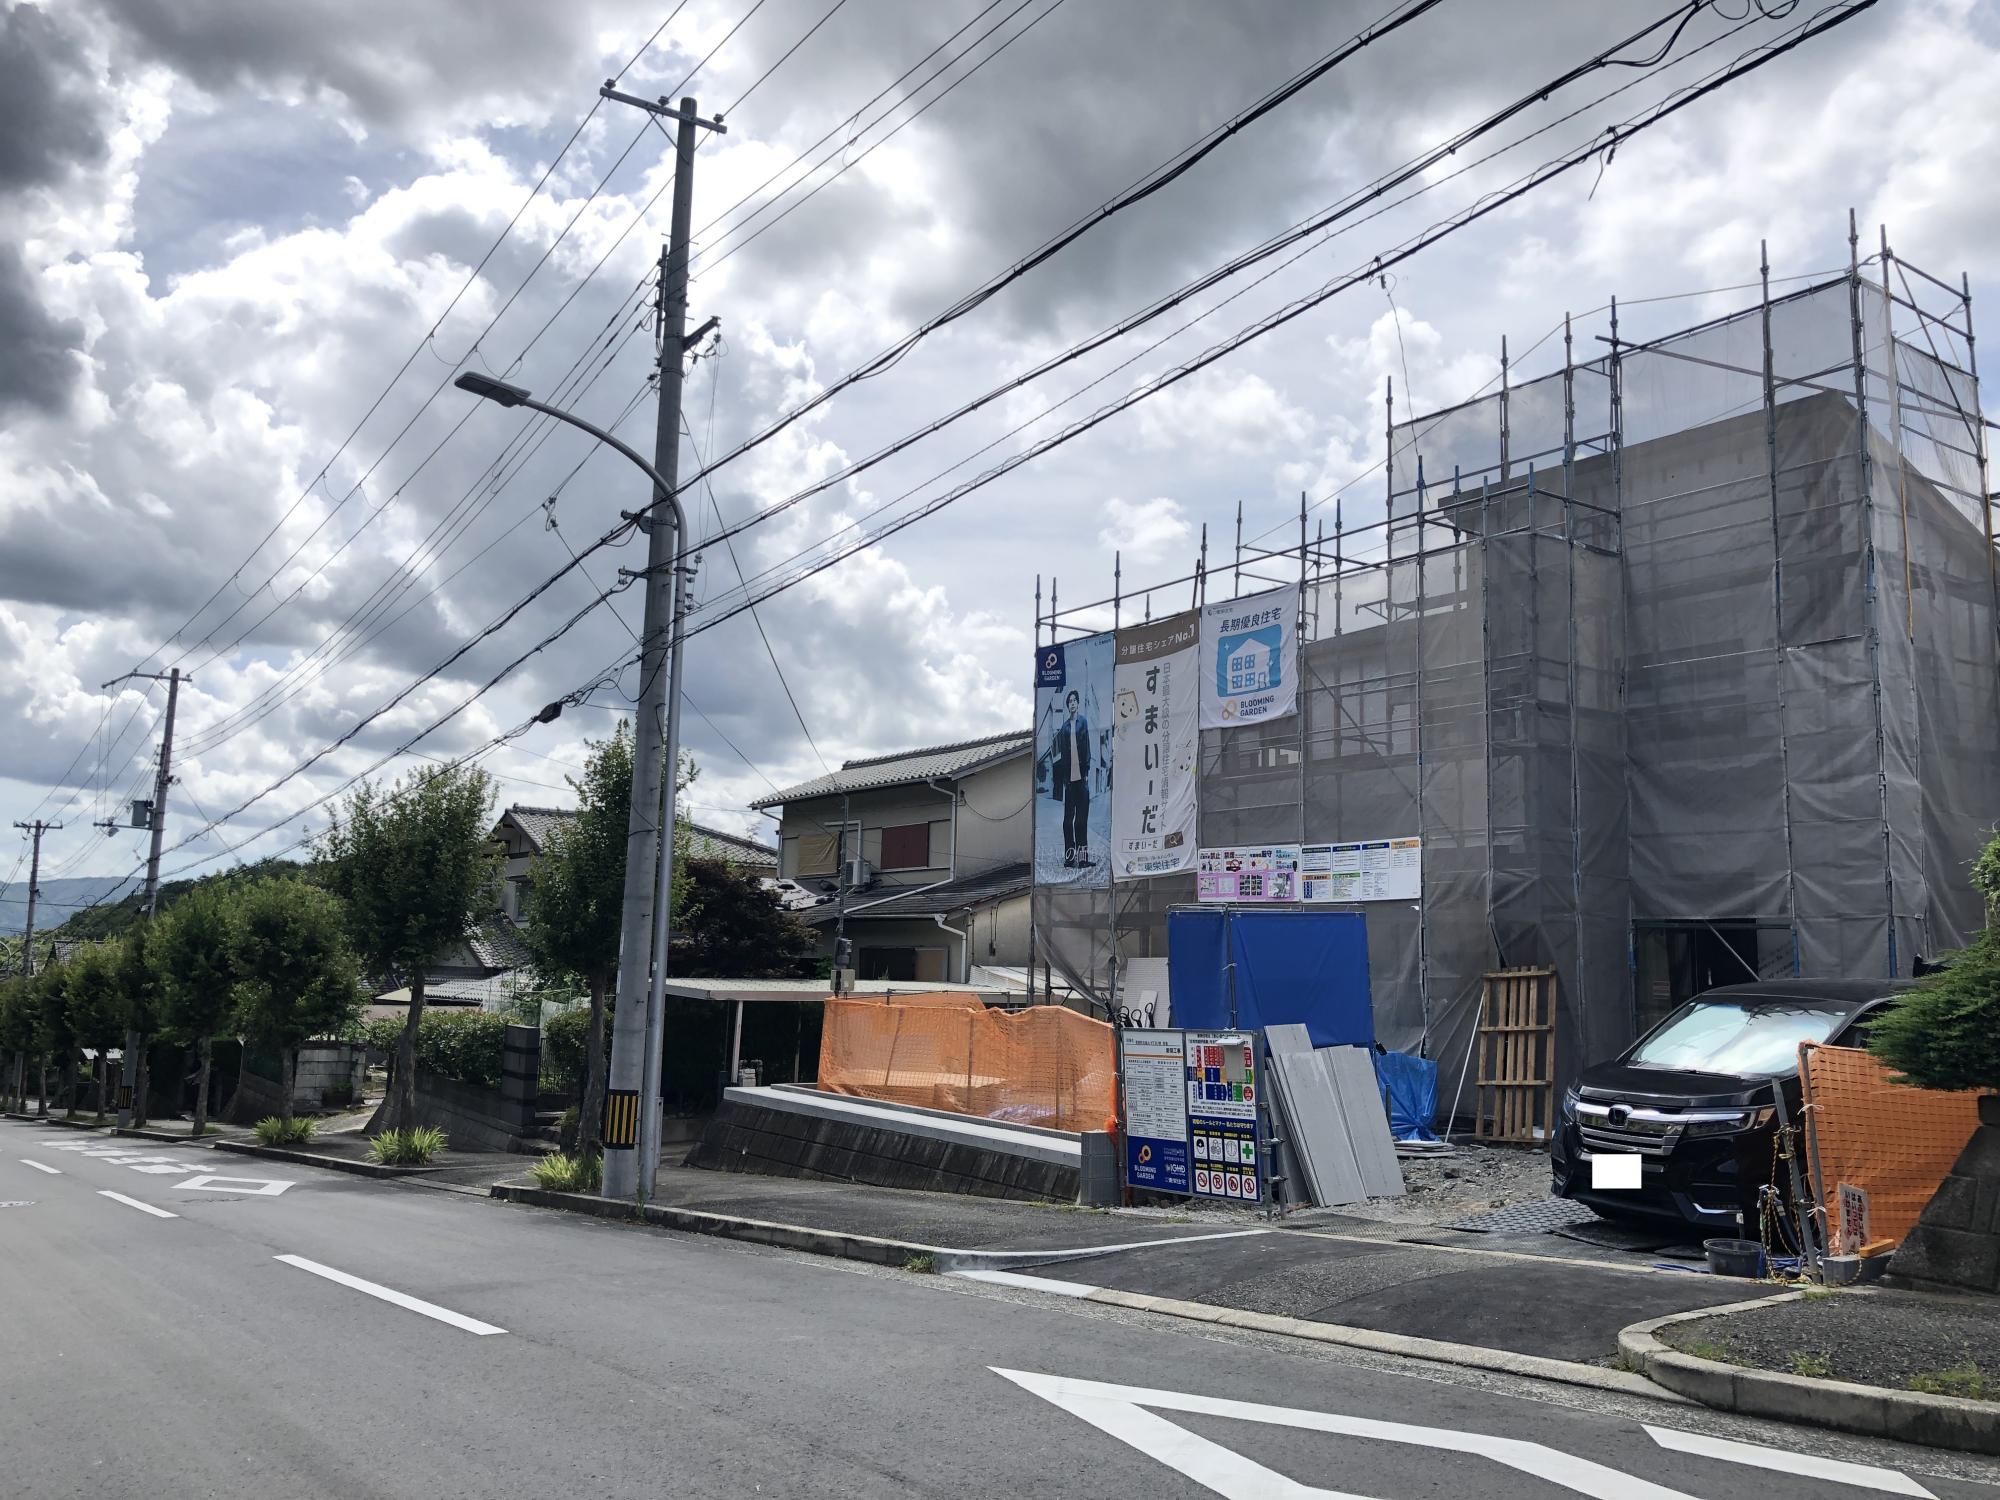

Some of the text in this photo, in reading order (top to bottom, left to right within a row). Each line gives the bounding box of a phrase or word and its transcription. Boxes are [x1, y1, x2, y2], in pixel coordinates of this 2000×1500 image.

[1219, 607, 1282, 633] 長期優良住宅
[1240, 695, 1275, 709] BLOOMING
[1240, 706, 1268, 717] GARDEN
[1141, 665, 1160, 834] すまいーだ
[1128, 839, 1158, 851] すまいーだ
[1144, 857, 1180, 872] 東栄住宅
